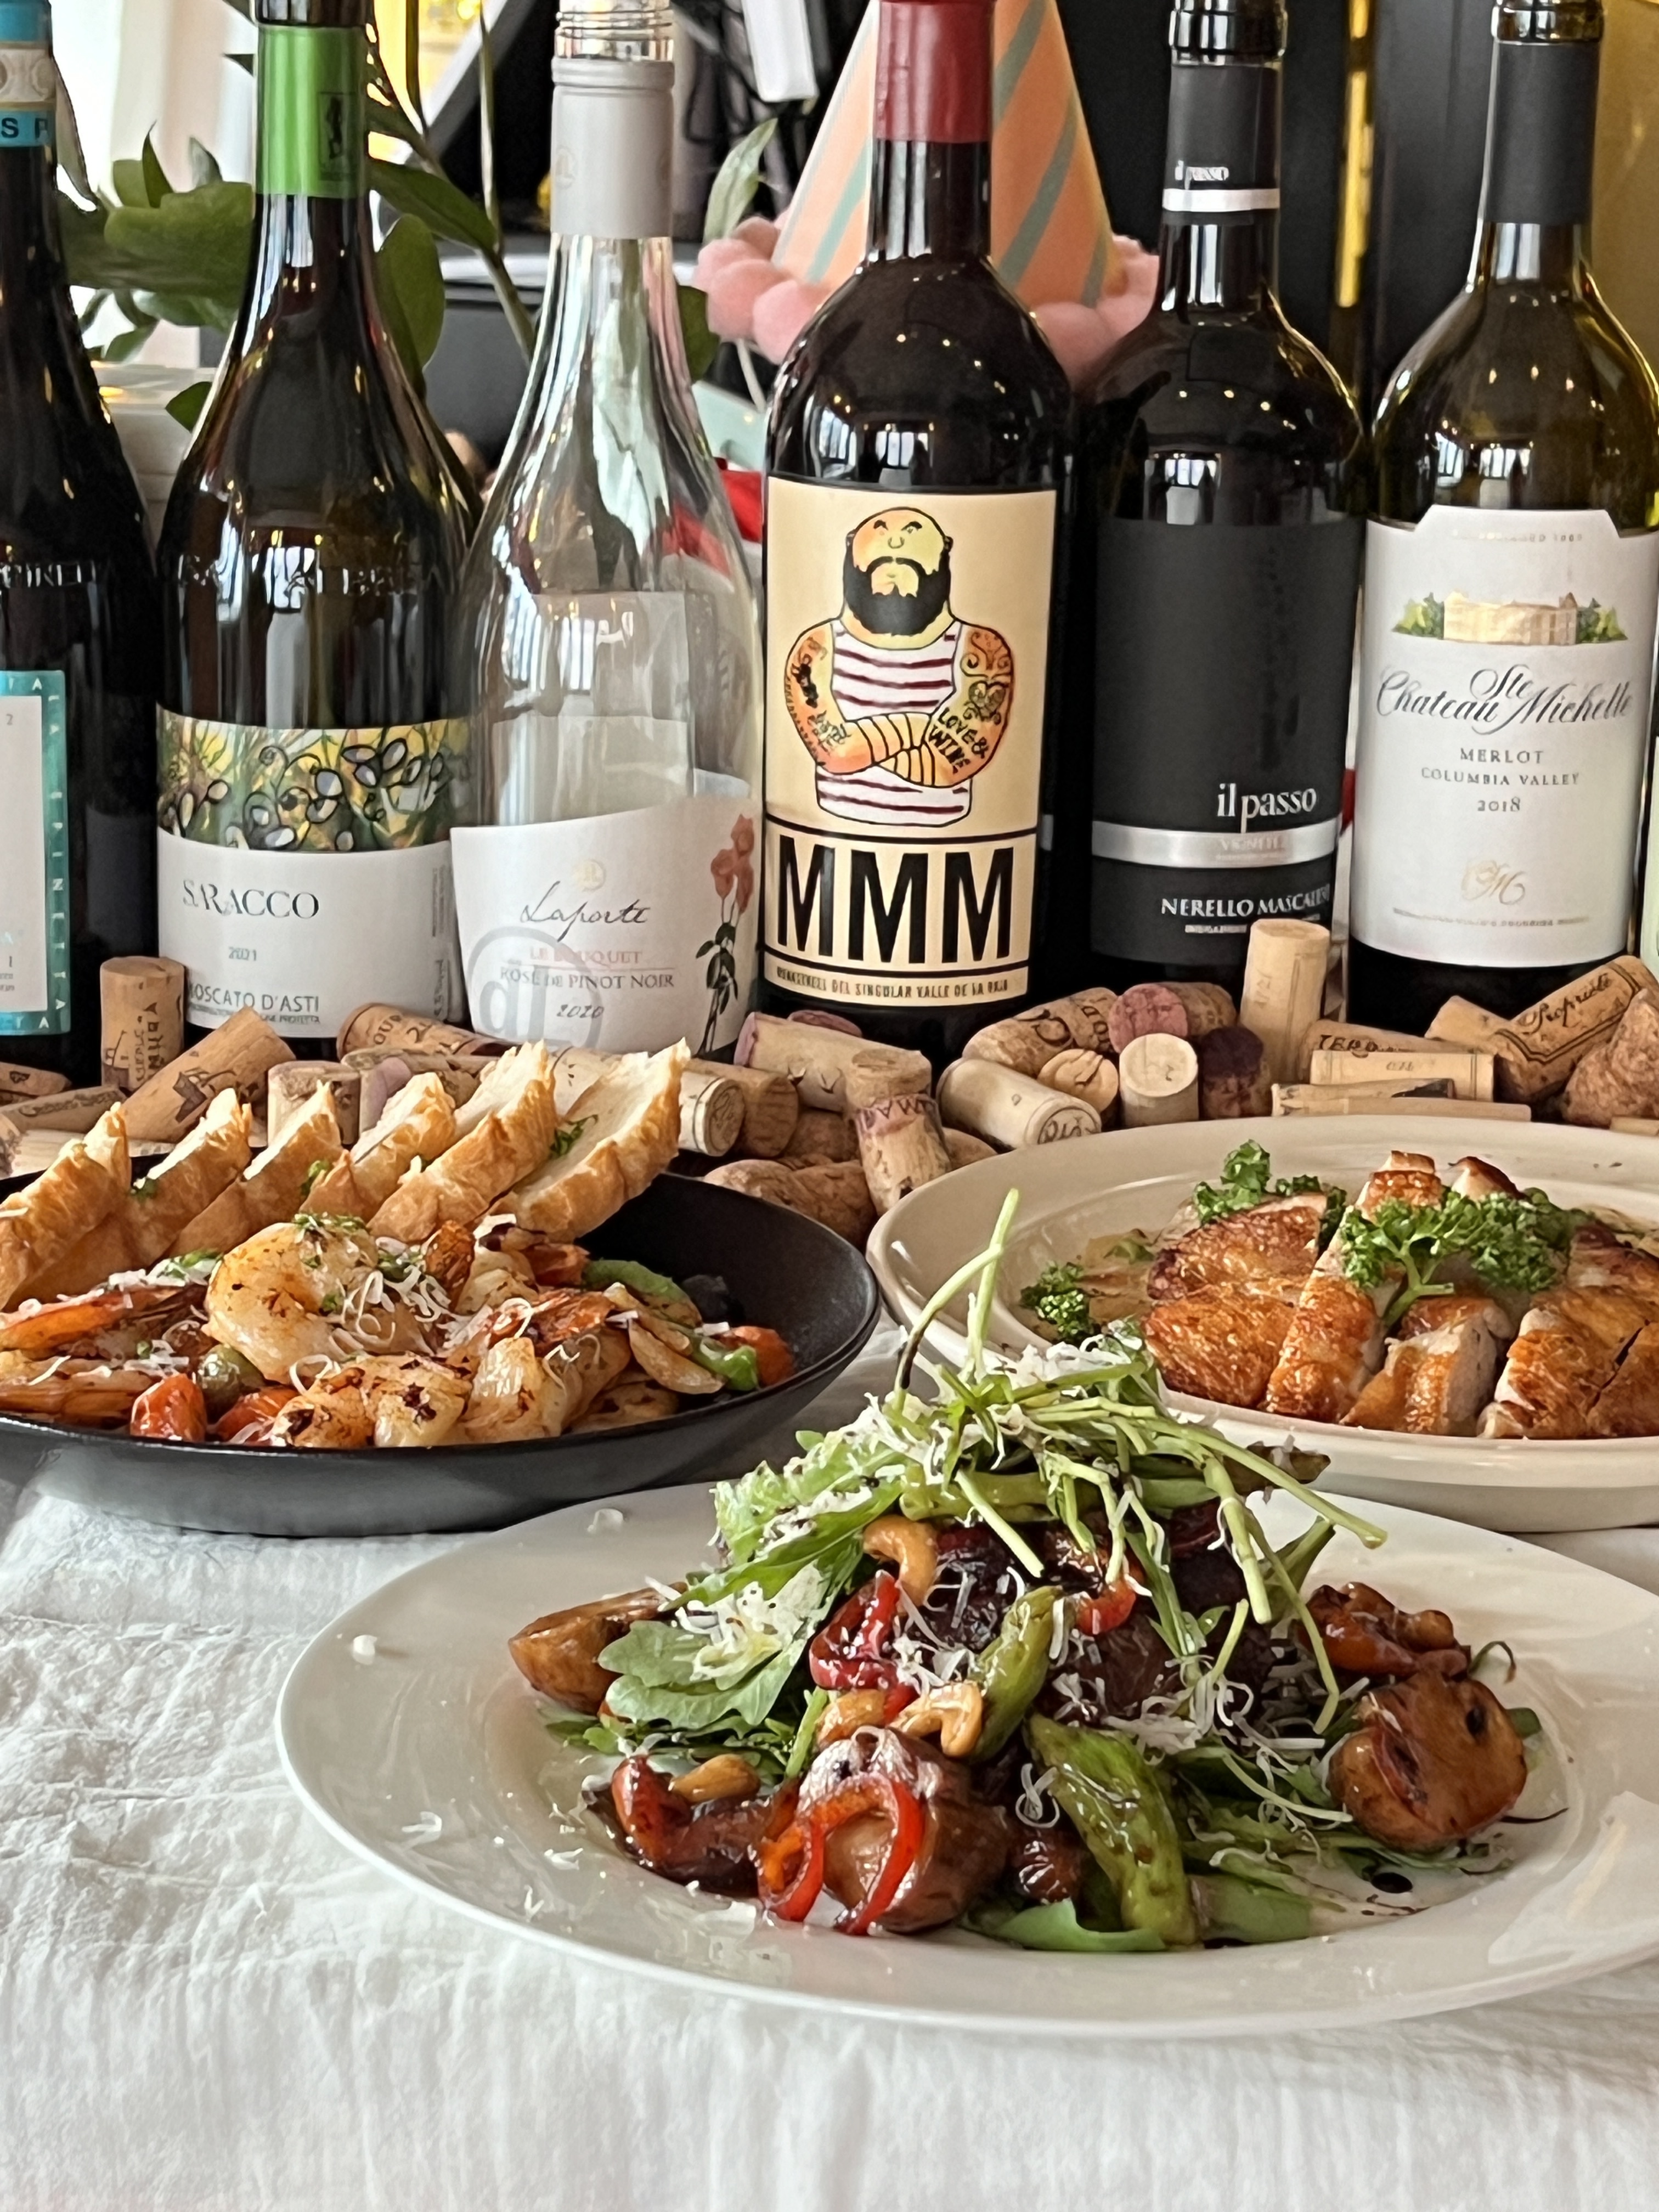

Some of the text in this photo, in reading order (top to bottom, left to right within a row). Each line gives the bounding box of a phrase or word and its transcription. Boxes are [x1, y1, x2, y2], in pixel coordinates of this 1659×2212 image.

[1469, 663, 1534, 701] Ste
[1376, 665, 1634, 735] Chateau Michelle
[1460, 748, 1544, 764] MERLOT
[1421, 767, 1580, 786] COLUMBIA VALLEY
[1217, 782, 1317, 834] il passo
[1477, 797, 1521, 812] 2018
[183, 879, 320, 919] SARACCO
[777, 834, 1014, 964] MMM
[1161, 898, 1254, 917] NERELLO
[520, 880, 651, 943] Laporte
[569, 973, 626, 989] PINOT
[630, 974, 675, 988] NOIR
[855, 983, 912, 998] SINGULAR
[917, 984, 949, 998] VALLE
[954, 983, 968, 997] DE
[261, 994, 319, 1012] D'ASTI
